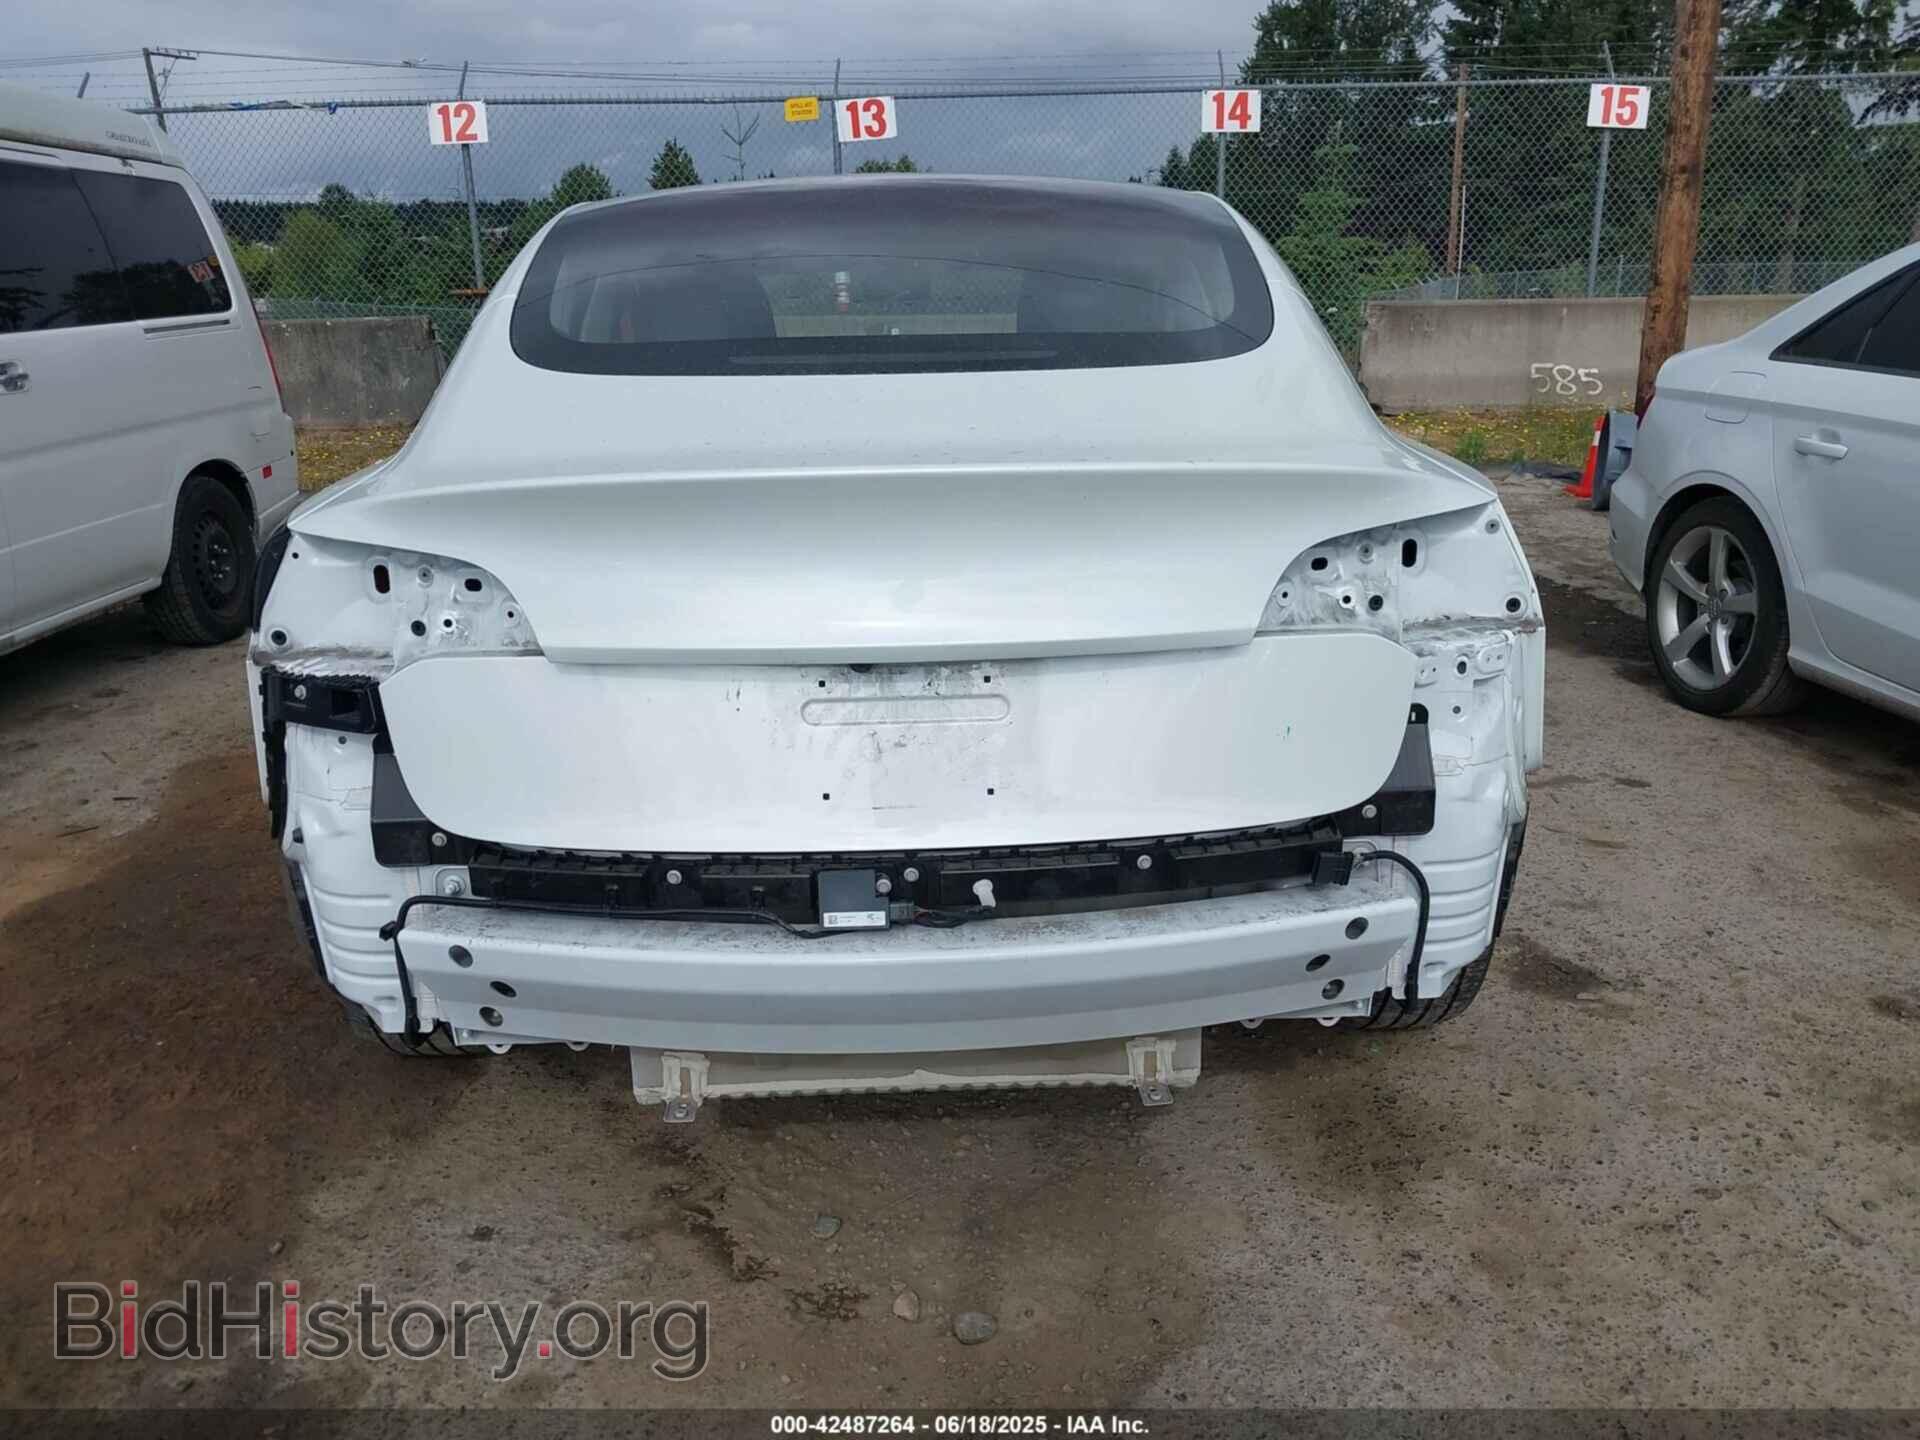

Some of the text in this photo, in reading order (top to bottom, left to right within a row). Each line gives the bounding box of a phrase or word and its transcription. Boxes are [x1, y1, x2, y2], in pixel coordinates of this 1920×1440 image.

[437, 103, 478, 142] 12
[846, 99, 887, 139] 13
[1212, 91, 1252, 130] 14
[1601, 86, 1640, 127] 15
[1530, 362, 1603, 395] 585
